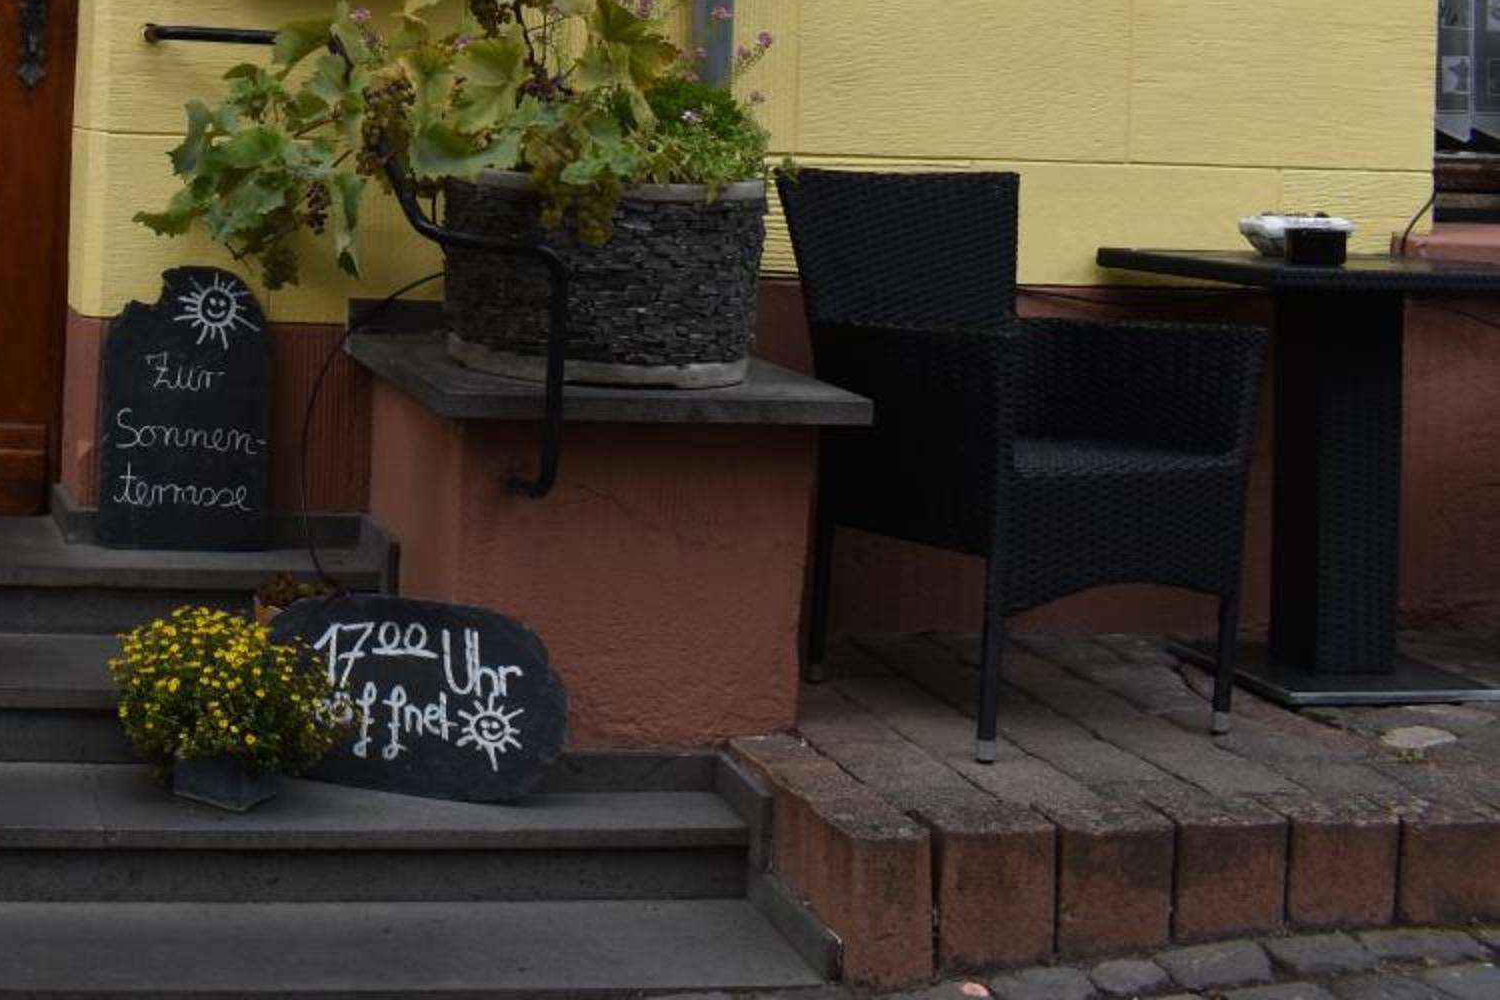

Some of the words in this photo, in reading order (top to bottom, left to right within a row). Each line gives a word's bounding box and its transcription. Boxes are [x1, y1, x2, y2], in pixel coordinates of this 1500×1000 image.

[144, 351, 227, 392] Zur
[115, 407, 268, 455] Sonnen-
[112, 459, 252, 512] terrasse
[442, 627, 523, 697] Uhr
